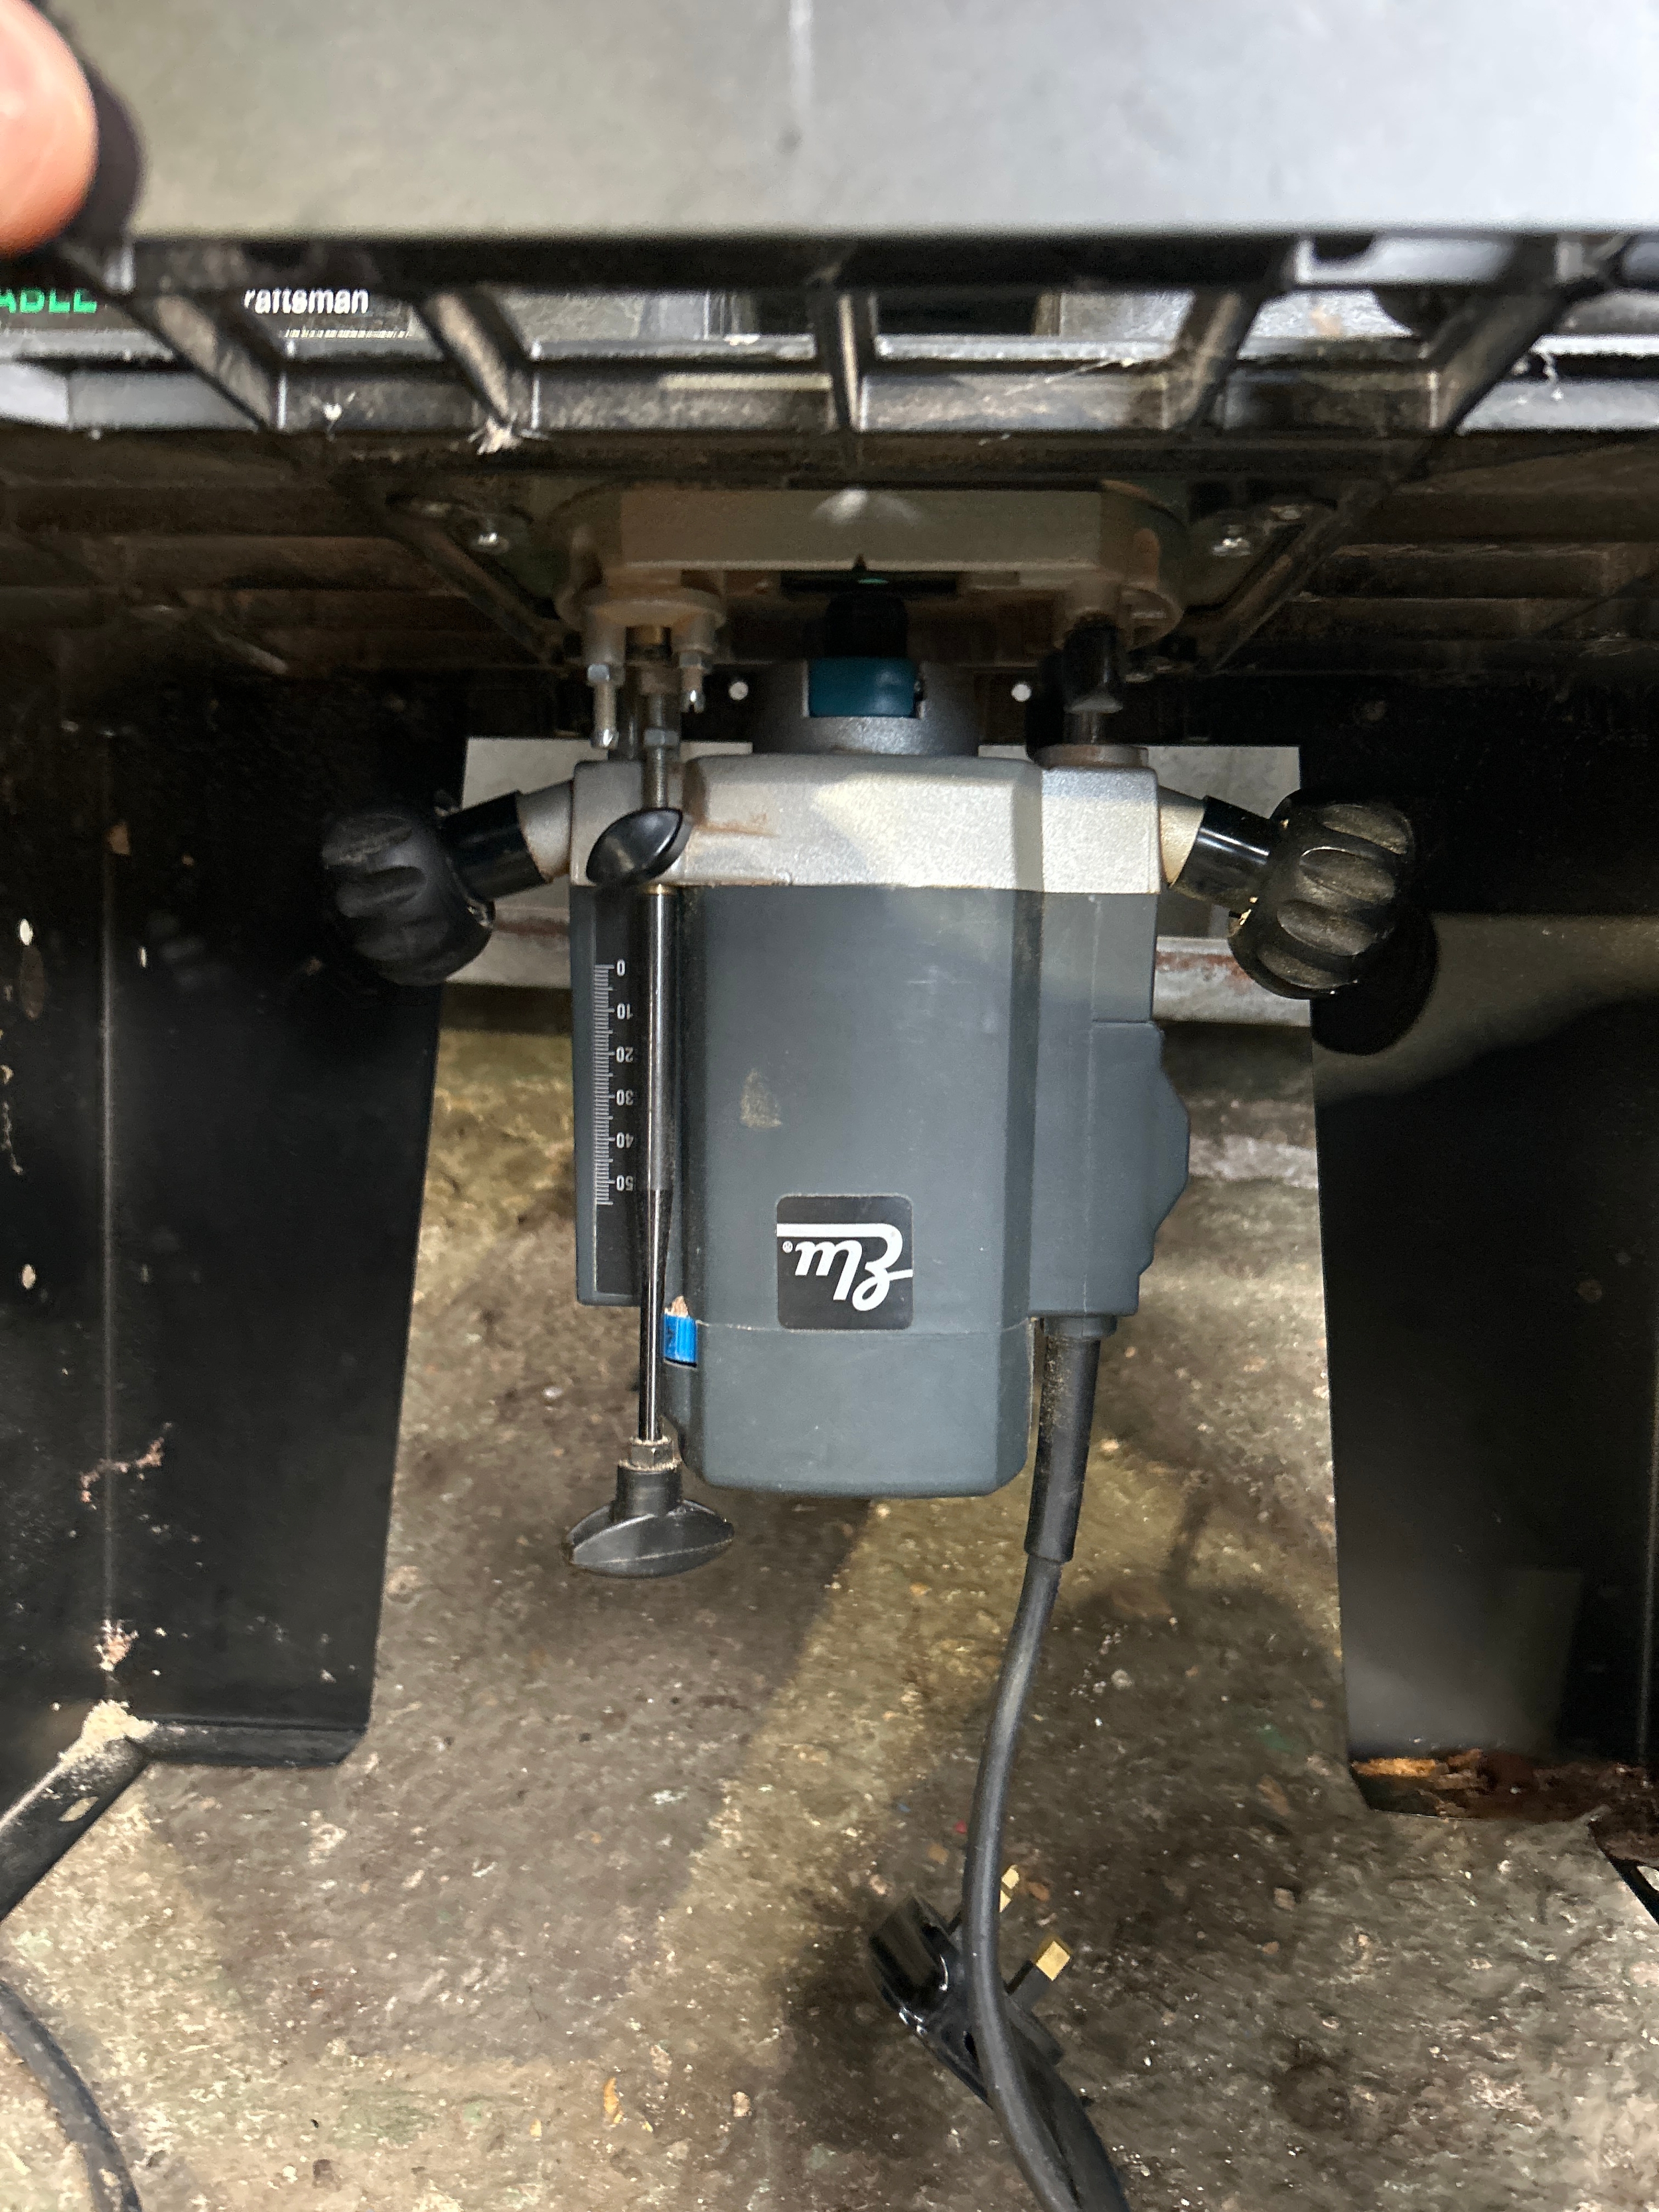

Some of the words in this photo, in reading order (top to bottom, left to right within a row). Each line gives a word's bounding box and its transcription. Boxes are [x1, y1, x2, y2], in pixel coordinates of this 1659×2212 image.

[616, 960, 625, 976] 0
[616, 1003, 633, 1019] 10
[616, 1047, 634, 1063] 20
[616, 1089, 634, 1106] 30
[616, 1132, 634, 1148] 40
[616, 1175, 634, 1191] 50
